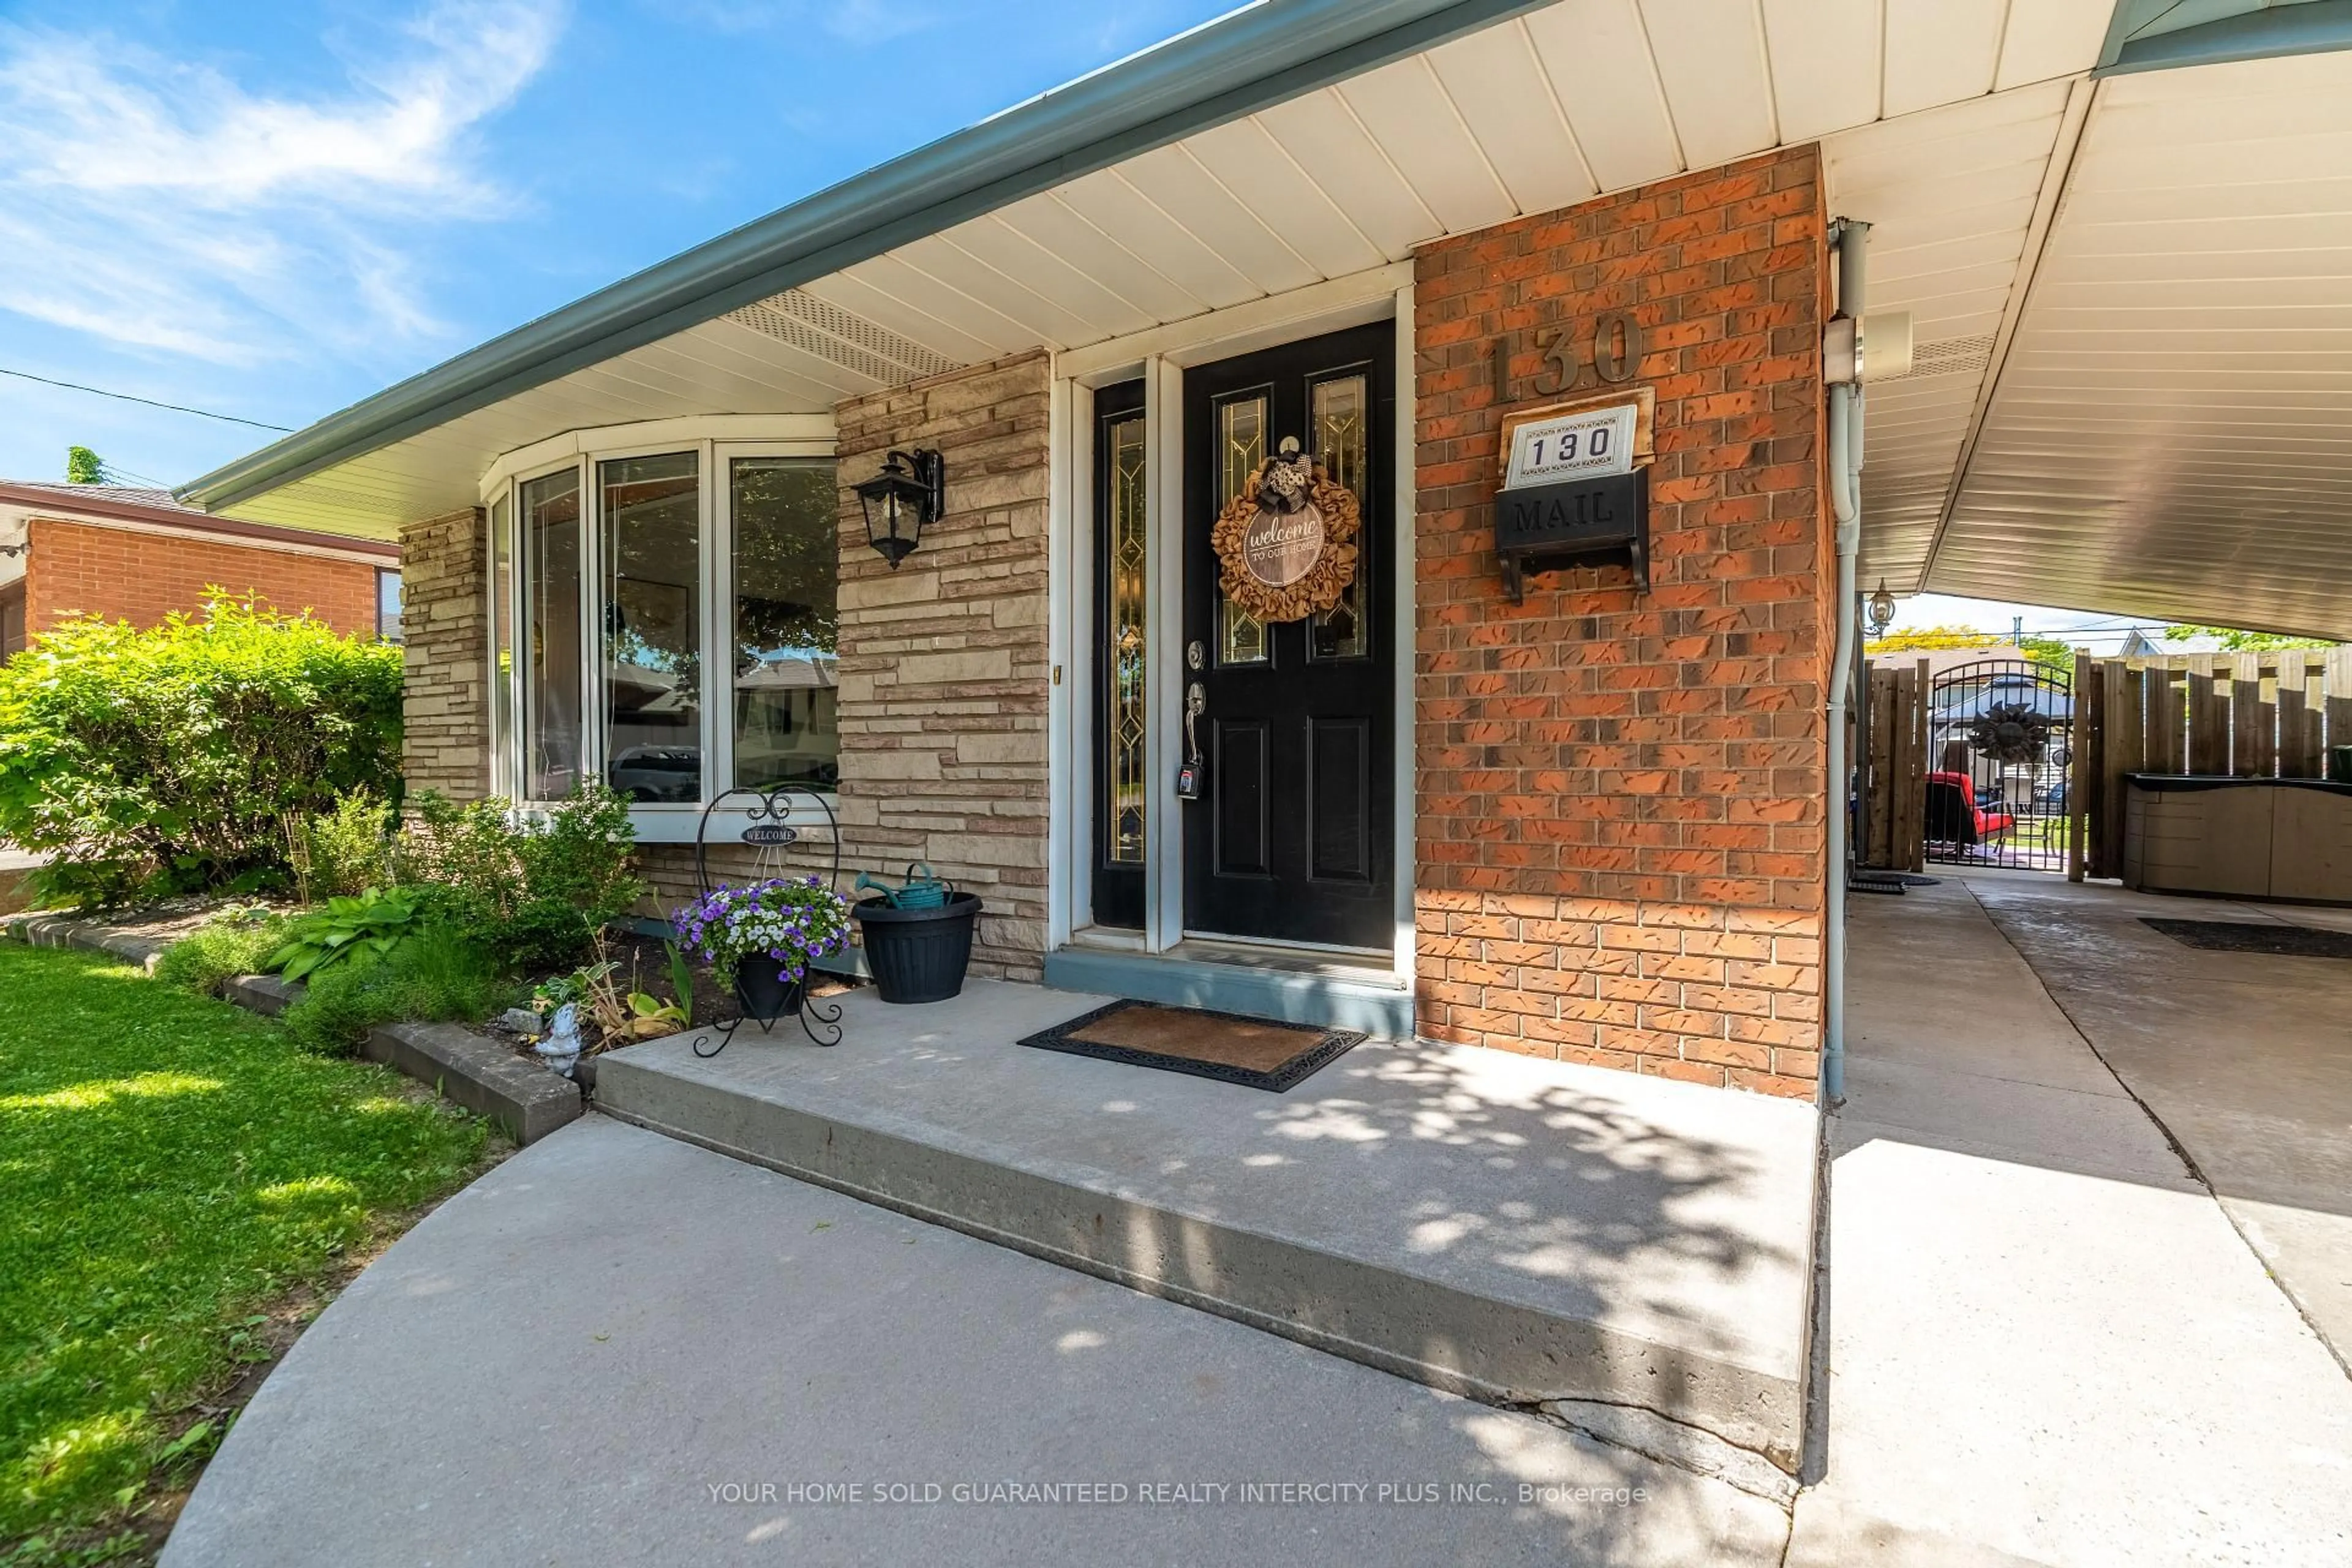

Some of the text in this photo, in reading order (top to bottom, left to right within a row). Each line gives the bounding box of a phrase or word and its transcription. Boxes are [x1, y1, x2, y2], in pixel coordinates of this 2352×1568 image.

[1489, 312, 1643, 404] 130
[1533, 428, 1609, 465] 130
[1514, 492, 1612, 532] MAIL
[1251, 517, 1316, 547] welcome
[1252, 541, 1316, 561] TO OUR HOME
[747, 831, 793, 840] WELCOME
